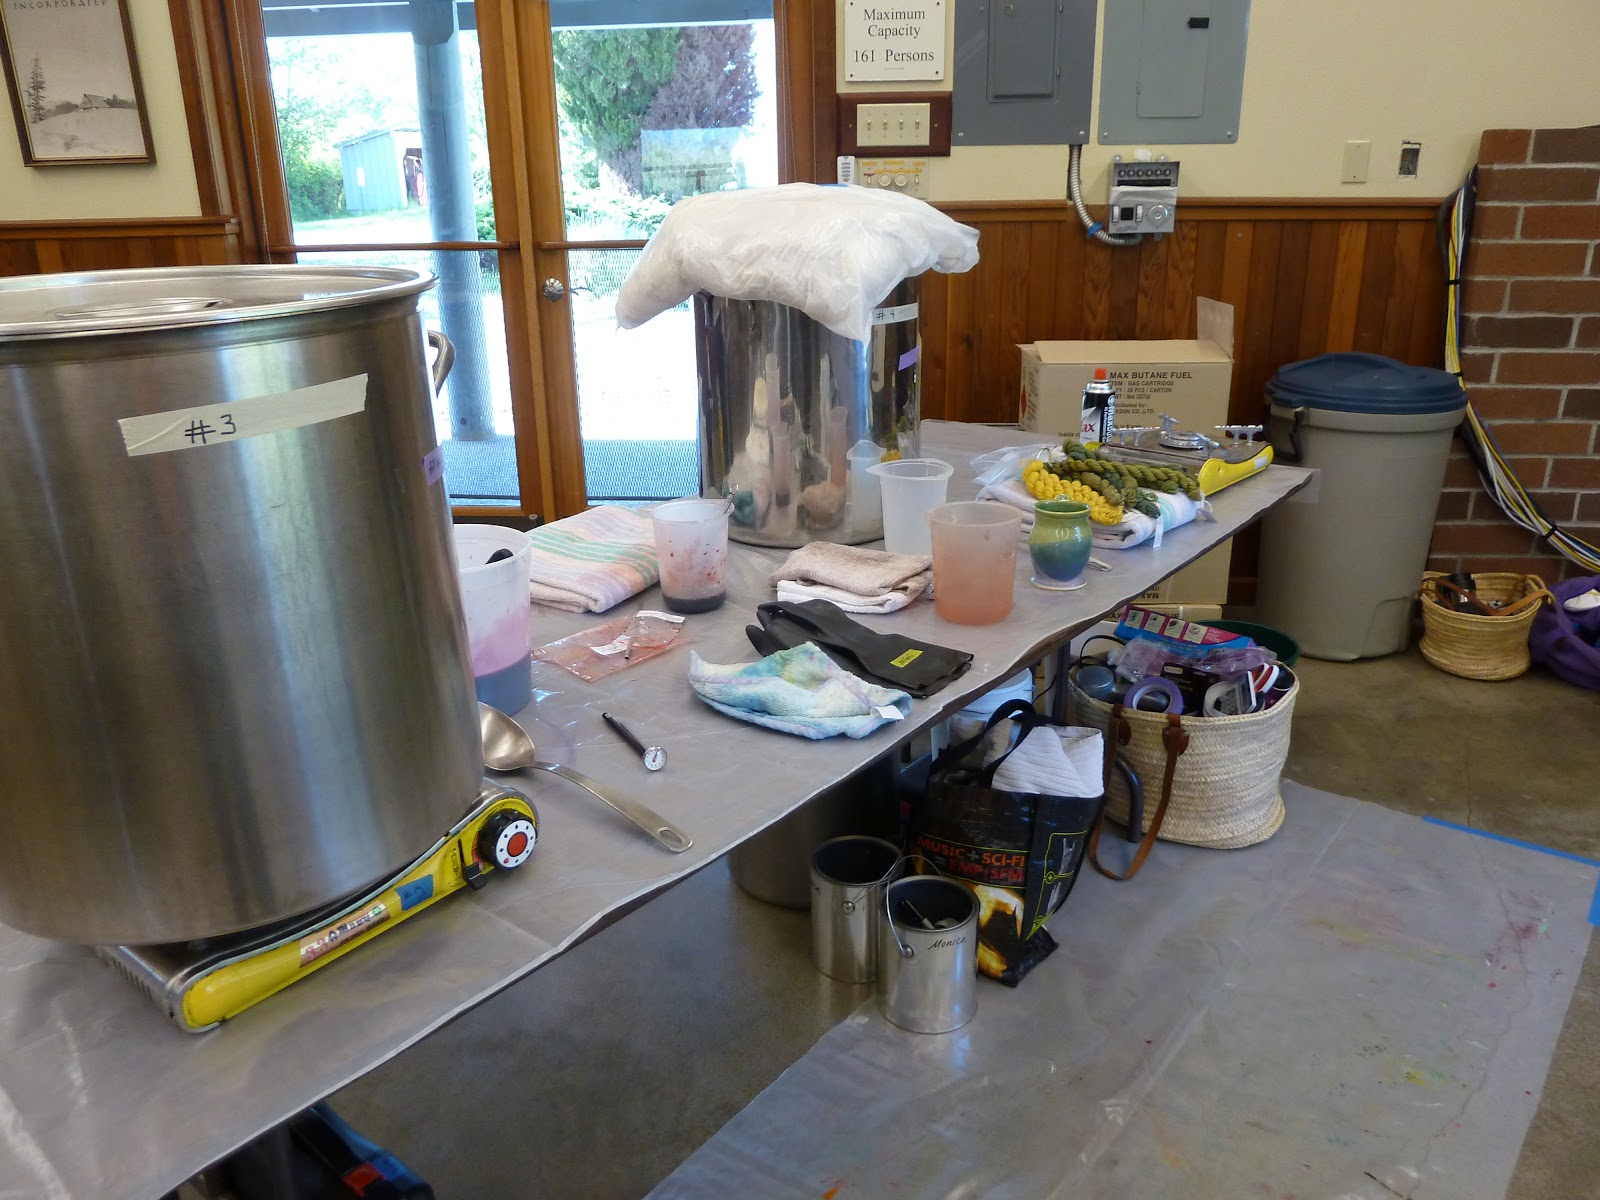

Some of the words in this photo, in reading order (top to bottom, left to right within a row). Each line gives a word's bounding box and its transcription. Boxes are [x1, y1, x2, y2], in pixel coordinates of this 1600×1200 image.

[863, 8, 926, 21] Maximum
[867, 24, 921, 39] Capacity
[854, 50, 875, 63] 161
[884, 49, 935, 62] Persons
[918, 835, 966, 859] MUSIC
[982, 852, 1025, 867] SCI-FI
